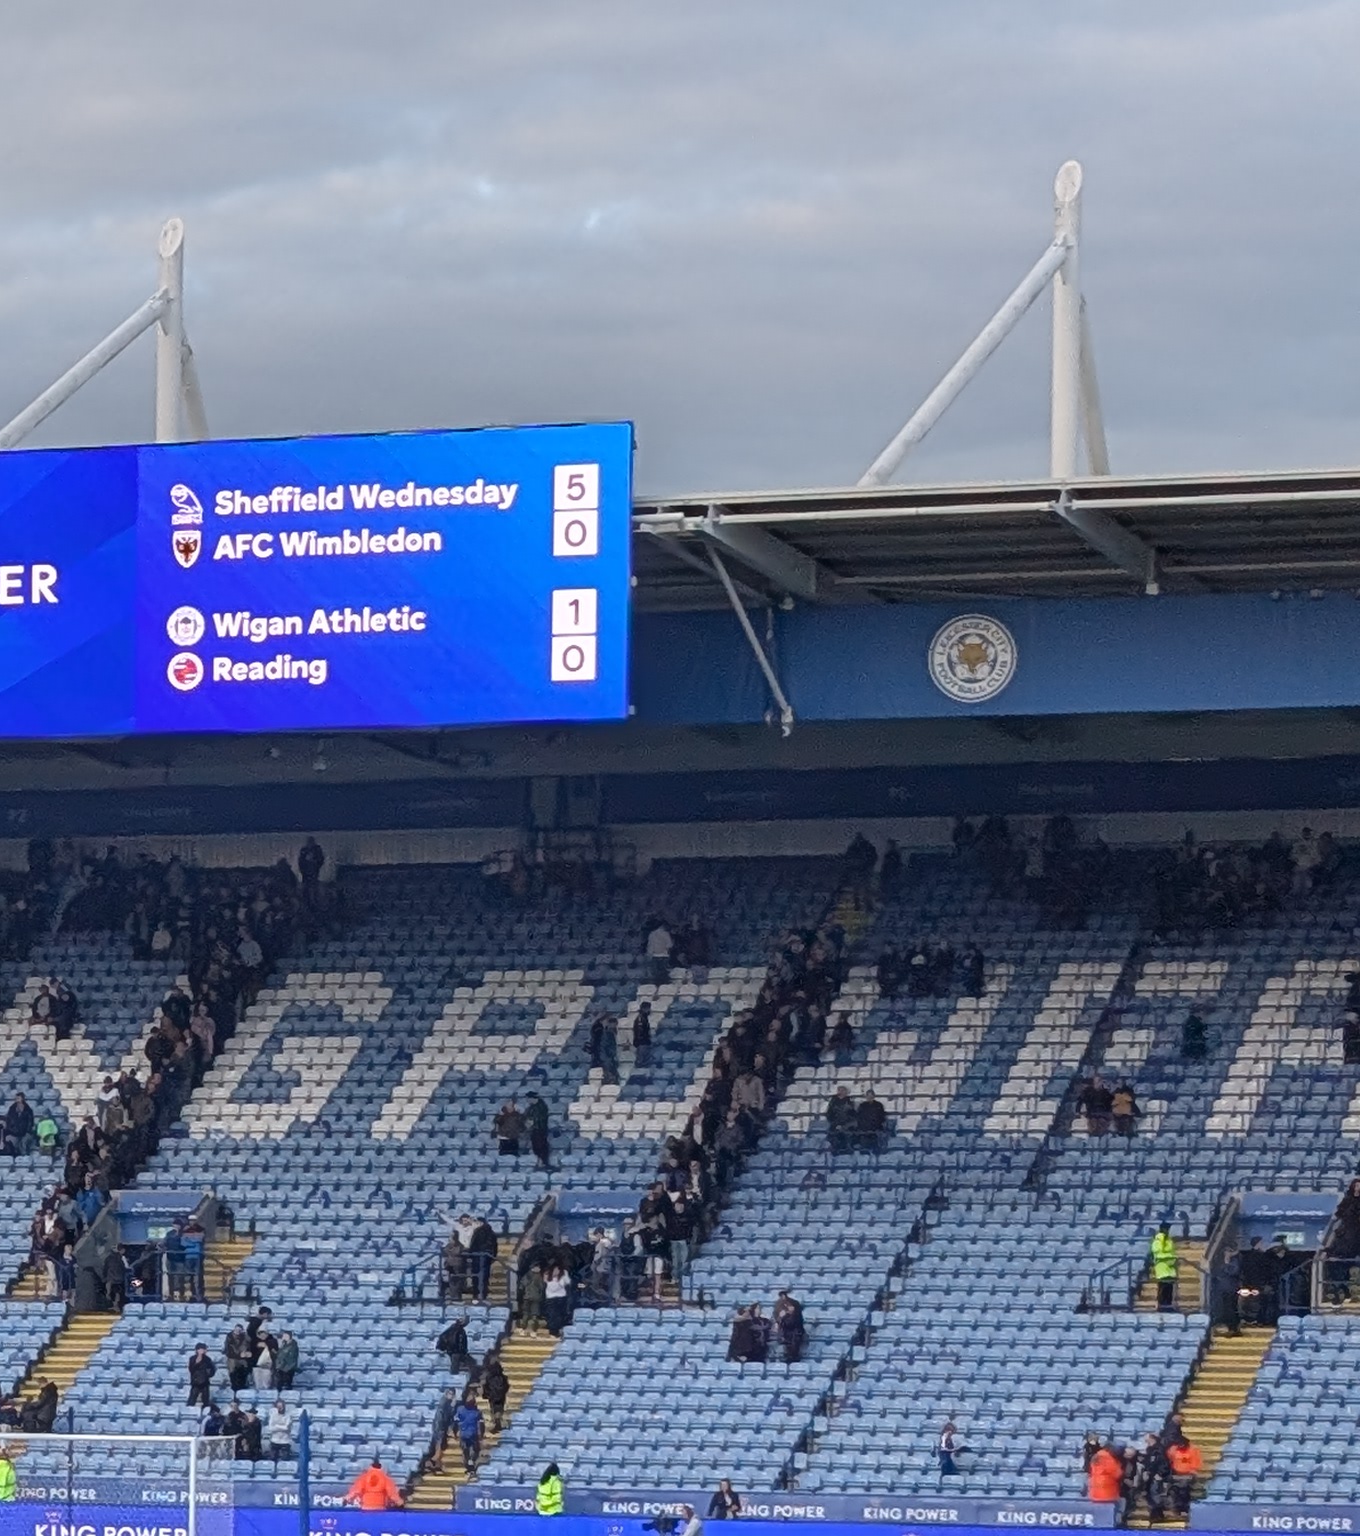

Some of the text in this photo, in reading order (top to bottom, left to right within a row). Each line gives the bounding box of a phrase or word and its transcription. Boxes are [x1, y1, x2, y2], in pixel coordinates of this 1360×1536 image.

[214, 478, 519, 516] Sheffield Wednesday
[566, 473, 586, 501] 5
[212, 527, 442, 561] AFC Wimbledon
[564, 520, 588, 547] 0
[568, 599, 581, 626] 1
[213, 605, 427, 643] Wigan Athletic
[561, 644, 586, 672] 0
[213, 654, 328, 685] Reading
[142, 1492, 176, 1504] KING
[274, 1493, 299, 1505] KIN
[475, 1499, 511, 1510] KING
[603, 1501, 640, 1513] KING
[773, 1505, 825, 1518] POWER
[863, 1508, 958, 1522] KING POWER
[998, 1512, 1095, 1528] KING POWER
[1252, 1516, 1353, 1531] KING POWER
